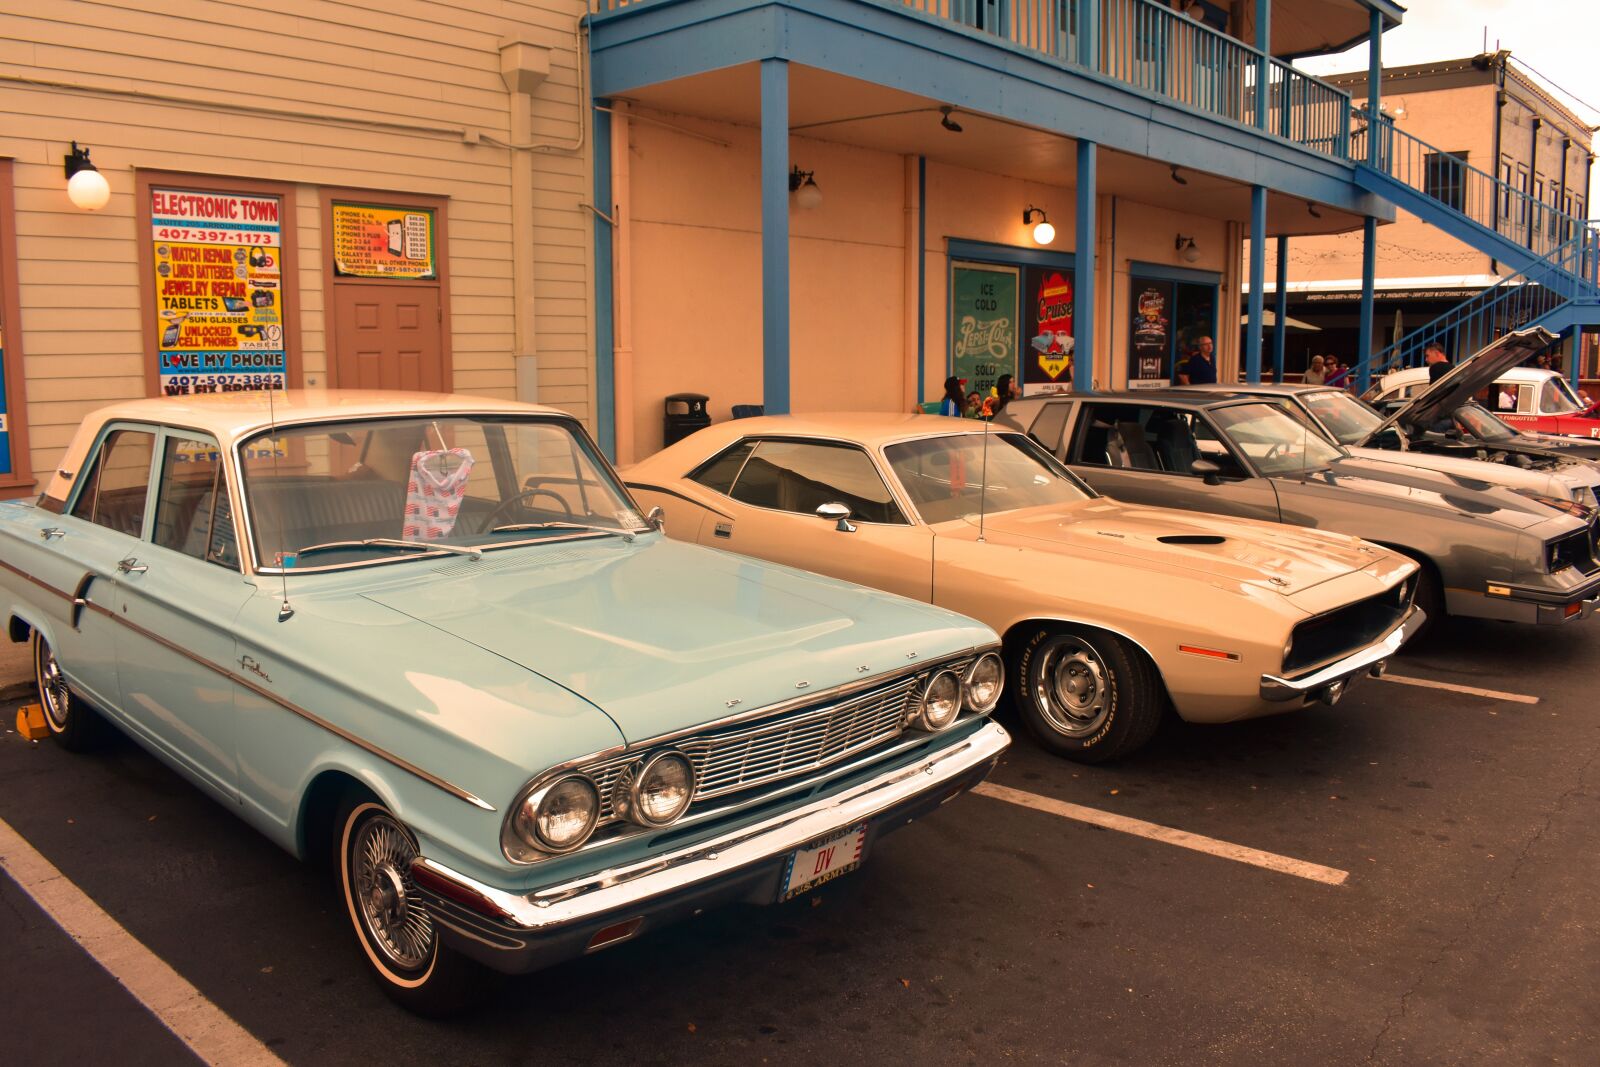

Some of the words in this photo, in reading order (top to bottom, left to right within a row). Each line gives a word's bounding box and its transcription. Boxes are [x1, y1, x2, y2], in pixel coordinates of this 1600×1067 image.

[153, 193, 238, 220] ELECTRONIC
[241, 200, 278, 222] TOWN
[159, 229, 272, 244] 407-397-1173
[171, 247, 201, 262] WATCH
[203, 248, 232, 263] REPAIR
[172, 264, 195, 278] LINKS
[196, 264, 235, 280] BATTERIES
[162, 280, 208, 296] JEWELRY
[211, 281, 247, 297] REPAIR
[980, 284, 995, 295] ICE
[162, 297, 218, 310] TABLETS
[975, 299, 997, 311] COLD
[1038, 298, 1073, 323] Cruise
[184, 326, 232, 337] UNLOCKED
[178, 337, 201, 347] CELL
[202, 337, 238, 347] PHONES
[204, 353, 226, 367] MY
[231, 352, 283, 367] PHONE
[975, 365, 996, 376] SOLD
[169, 375, 282, 386] 407-507-3842
